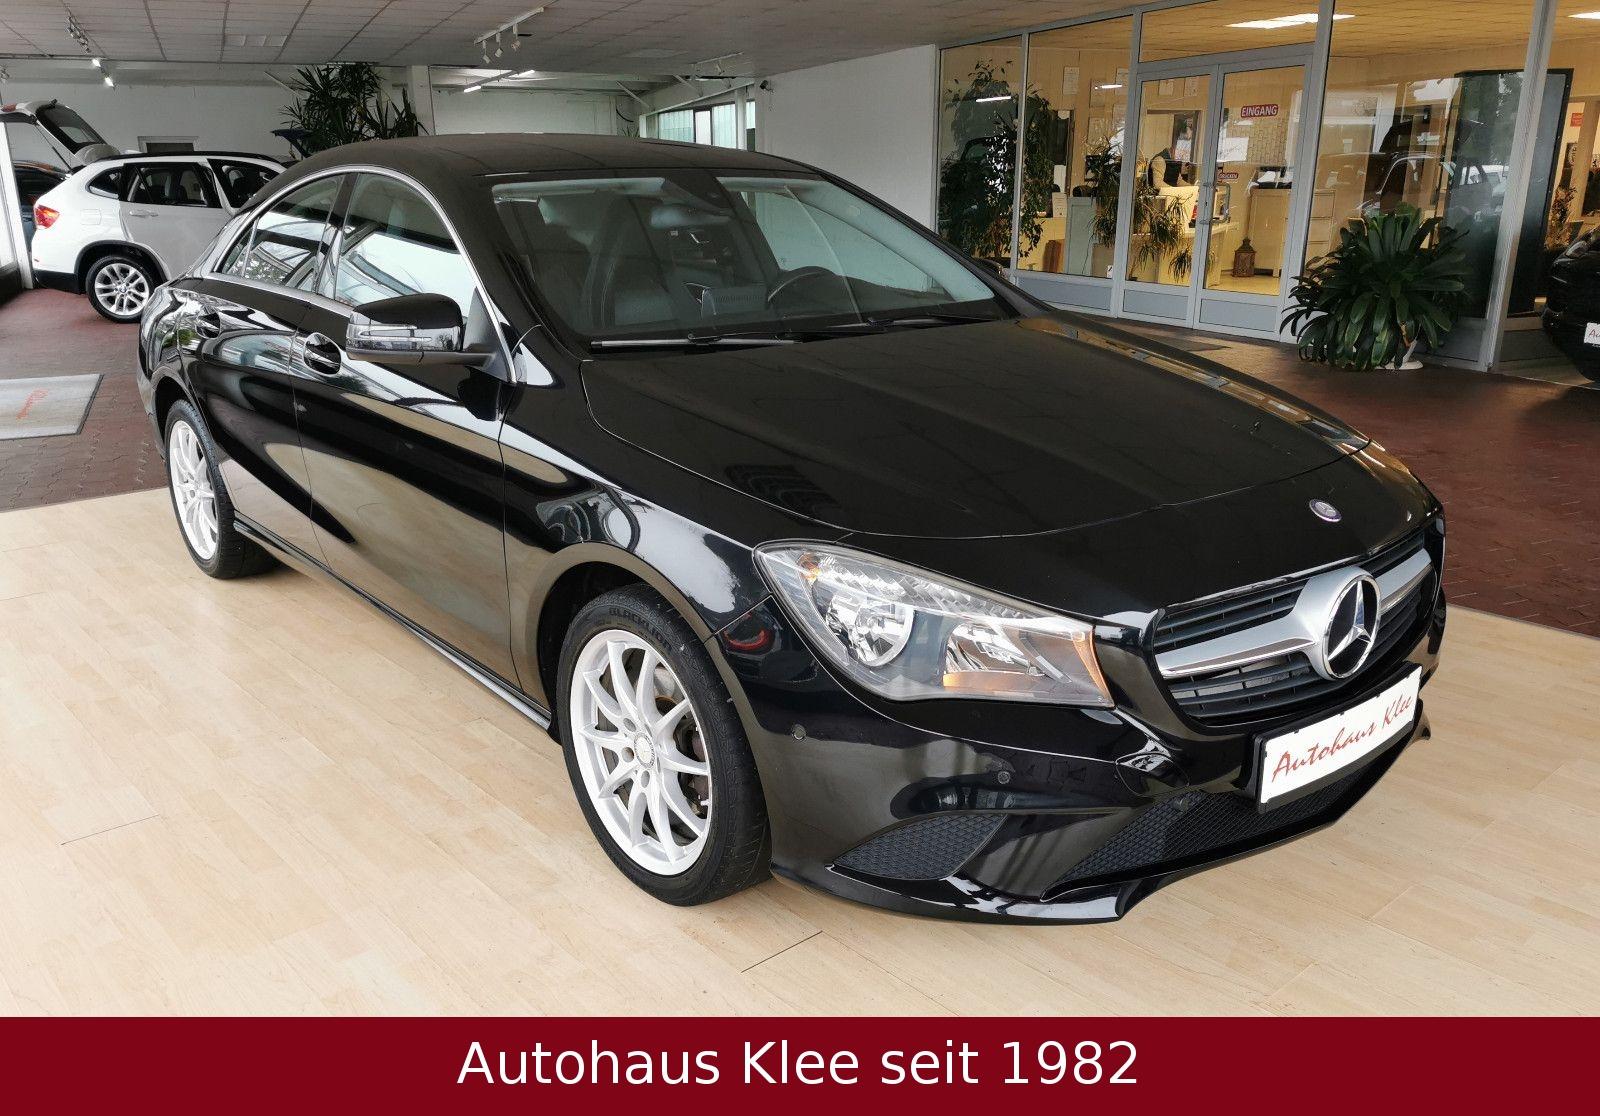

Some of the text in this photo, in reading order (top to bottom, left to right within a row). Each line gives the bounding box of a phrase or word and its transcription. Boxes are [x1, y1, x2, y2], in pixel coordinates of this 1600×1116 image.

[1241, 106, 1277, 116] EINGANG
[1272, 695, 1412, 783] Autohaus Klee
